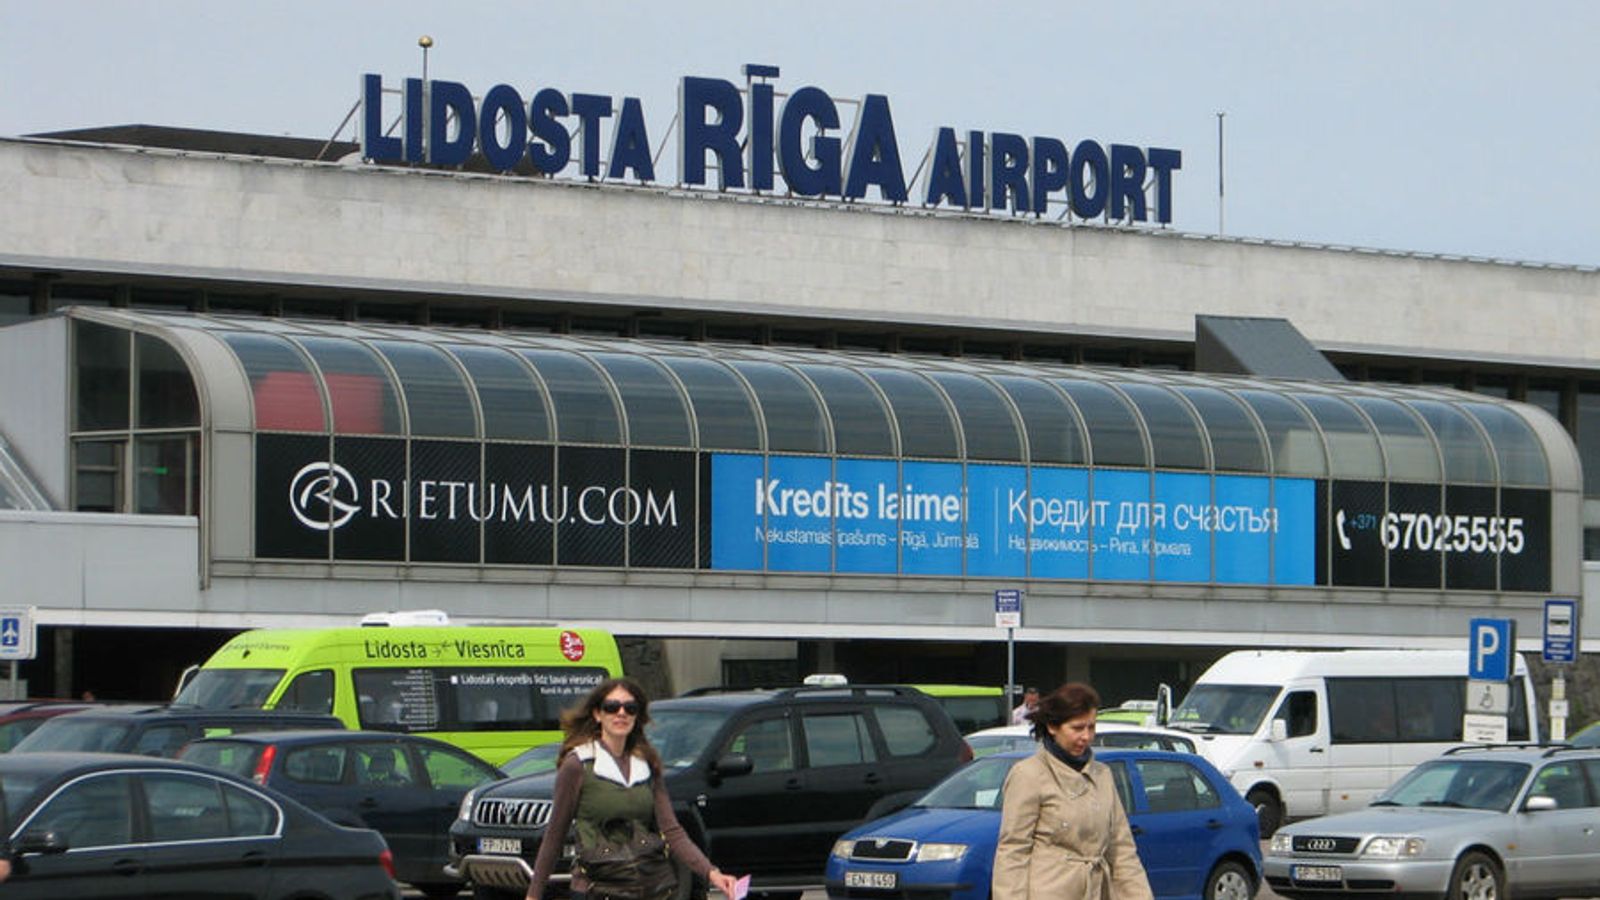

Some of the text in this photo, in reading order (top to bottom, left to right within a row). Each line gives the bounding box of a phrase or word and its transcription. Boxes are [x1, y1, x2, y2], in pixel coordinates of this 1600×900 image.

[361, 63, 1182, 224] LIDOSTA RĪGA AIRPORT
[370, 477, 679, 528] RIETUMU.COM
[1008, 488, 1279, 536] Кредит для счастья
[1380, 511, 1525, 555] 67025555
[365, 639, 427, 659] Lidosta
[1477, 624, 1501, 673] P
